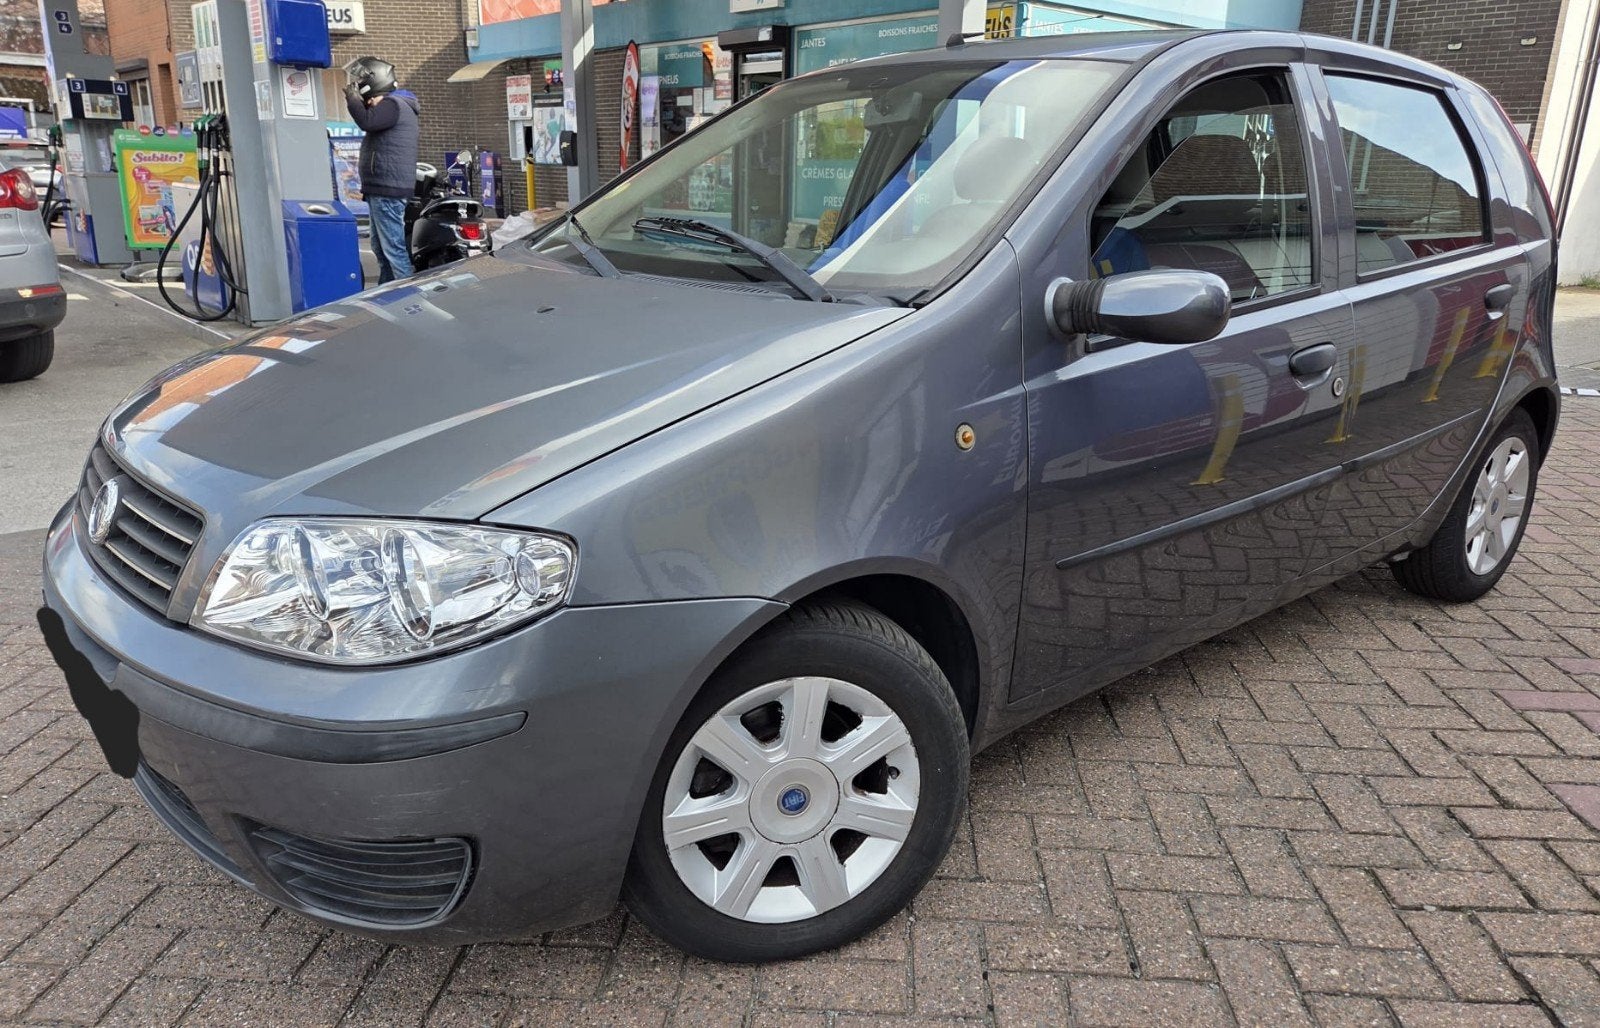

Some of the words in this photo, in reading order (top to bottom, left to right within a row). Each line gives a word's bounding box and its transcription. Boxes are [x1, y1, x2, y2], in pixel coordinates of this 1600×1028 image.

[60, 12, 66, 20] 3
[878, 26, 908, 38] BOISSONS
[801, 37, 826, 48] JANTES
[660, 75, 679, 84] PNEUS
[75, 82, 82, 90] 3
[116, 84, 123, 92] 4
[132, 152, 184, 163] Subito!
